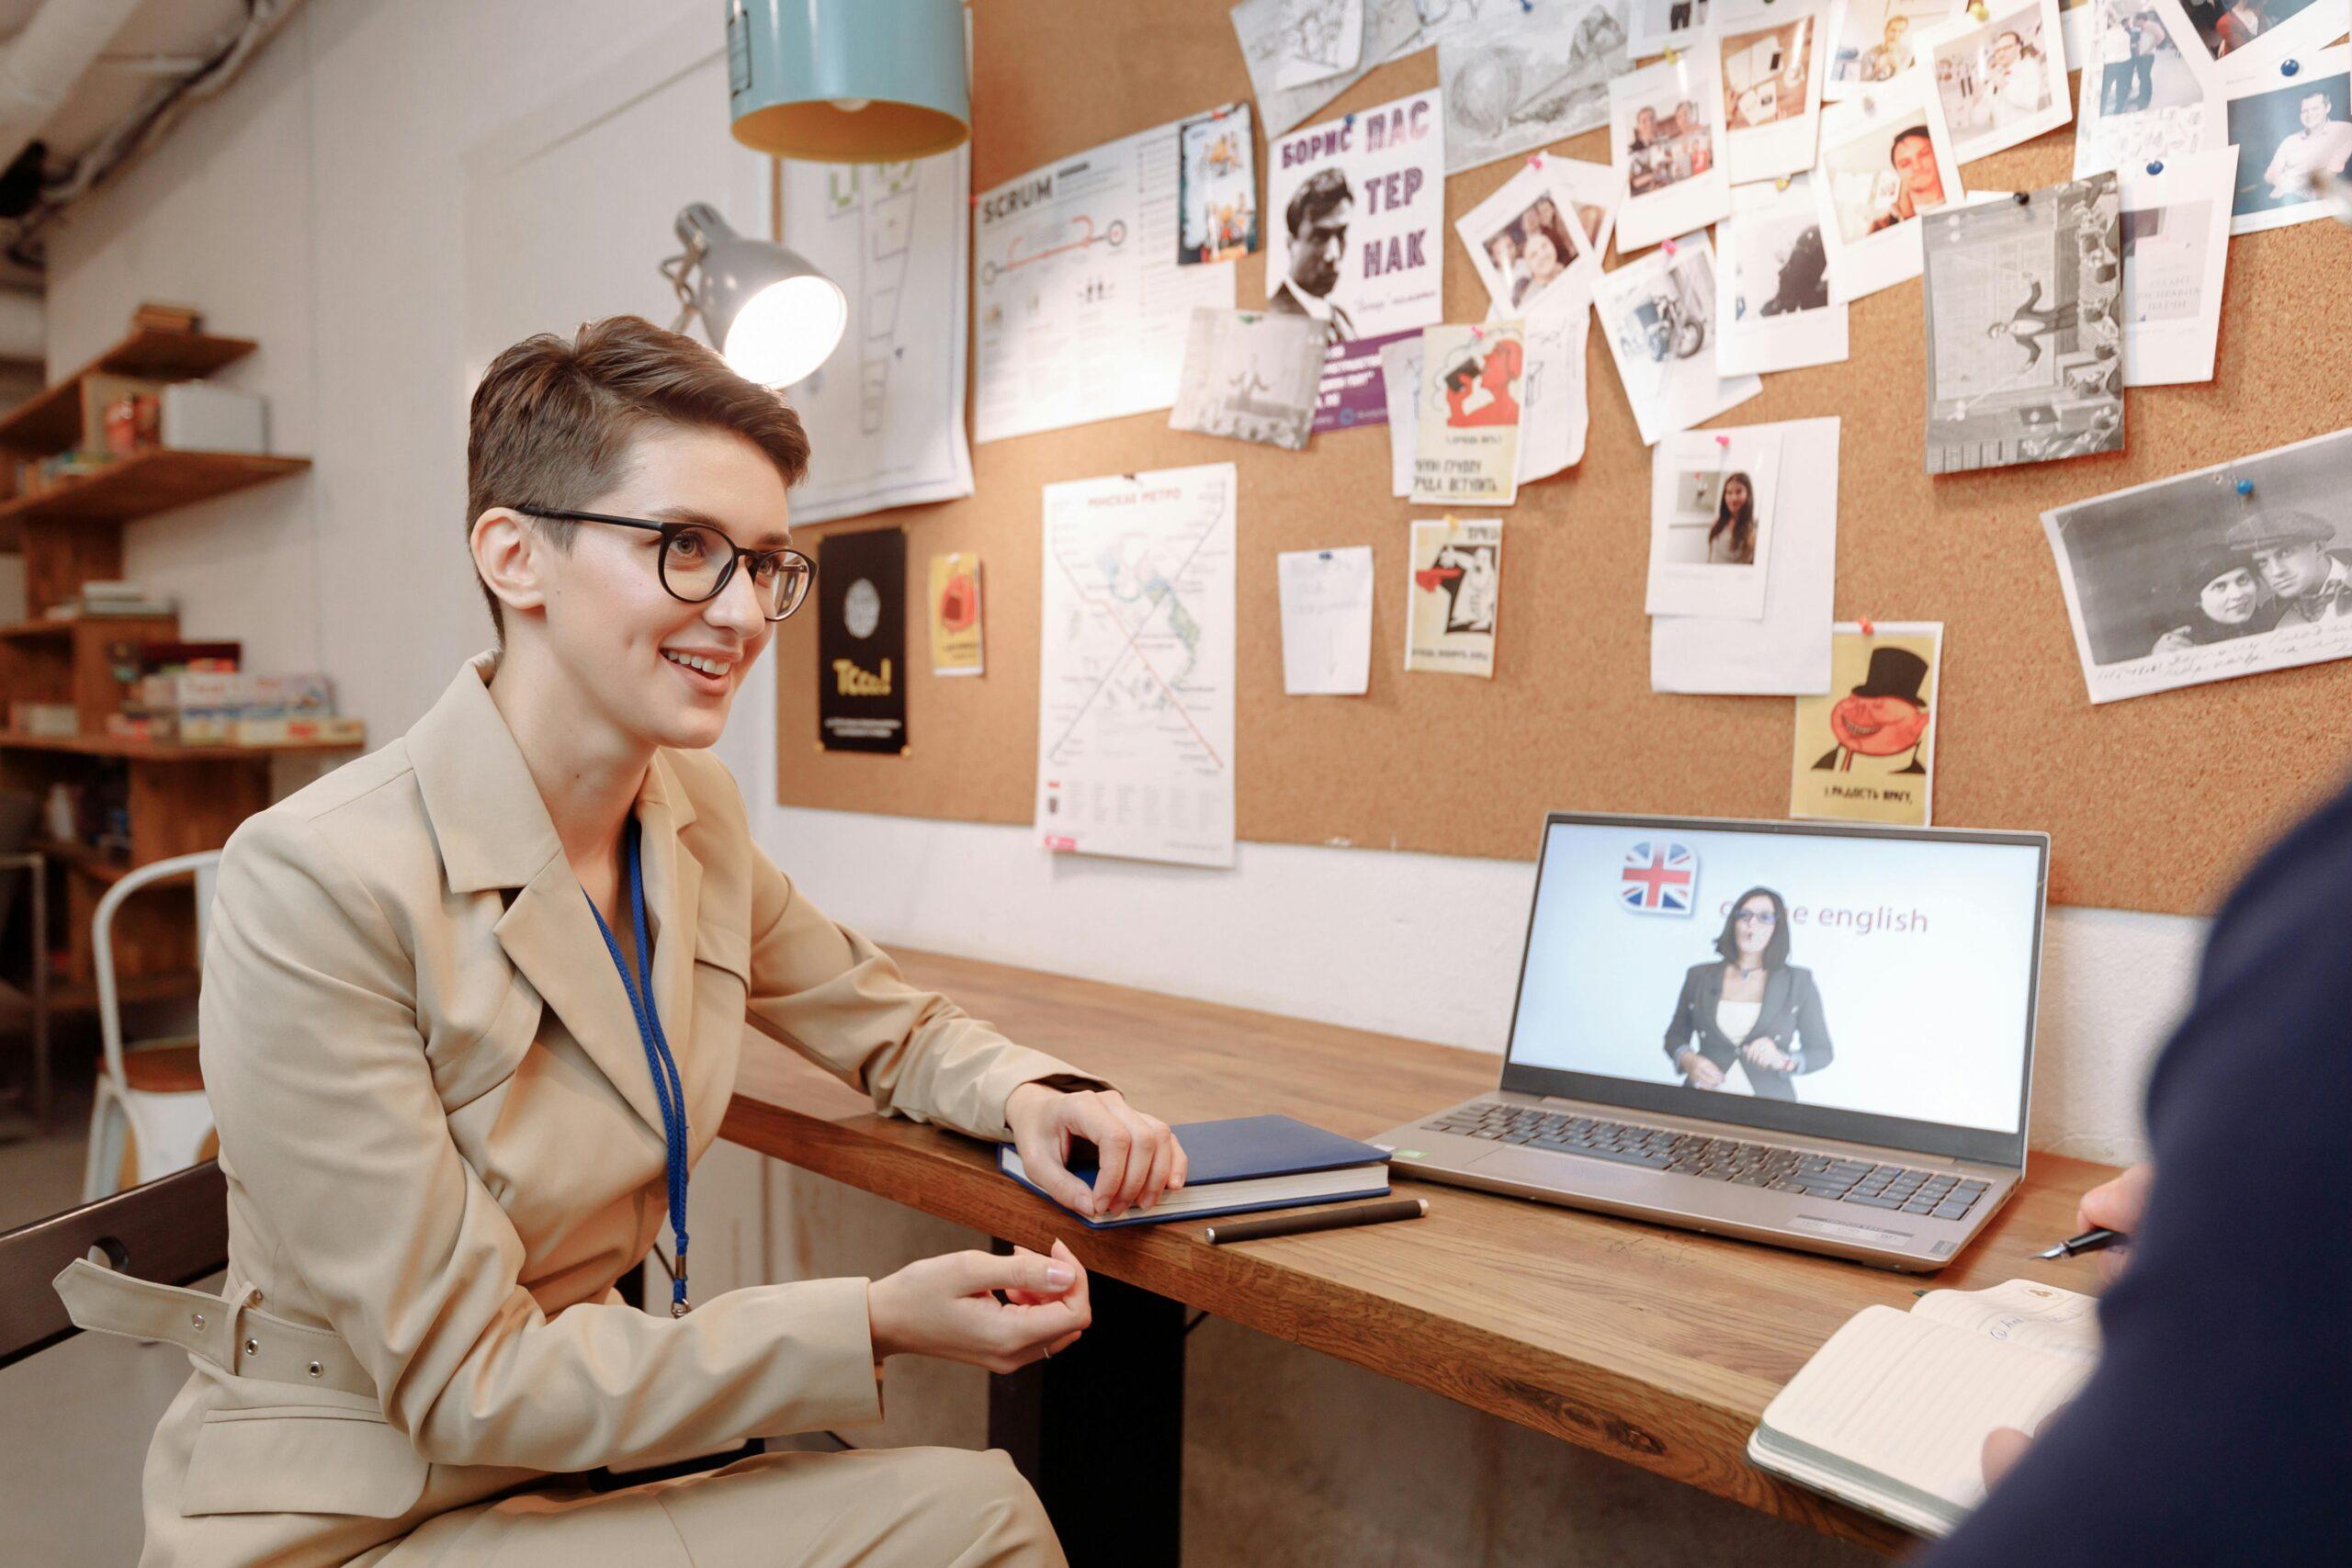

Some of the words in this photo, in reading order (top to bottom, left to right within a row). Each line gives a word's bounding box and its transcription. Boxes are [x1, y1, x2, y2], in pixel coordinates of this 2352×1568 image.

[1282, 124, 1353, 169] БОРИС
[1366, 100, 1430, 153] ПАС
[983, 175, 1053, 223] SCRUM
[1364, 166, 1424, 215] ТЕР
[1363, 230, 1427, 279] НАК
[1818, 906, 1928, 935] english
